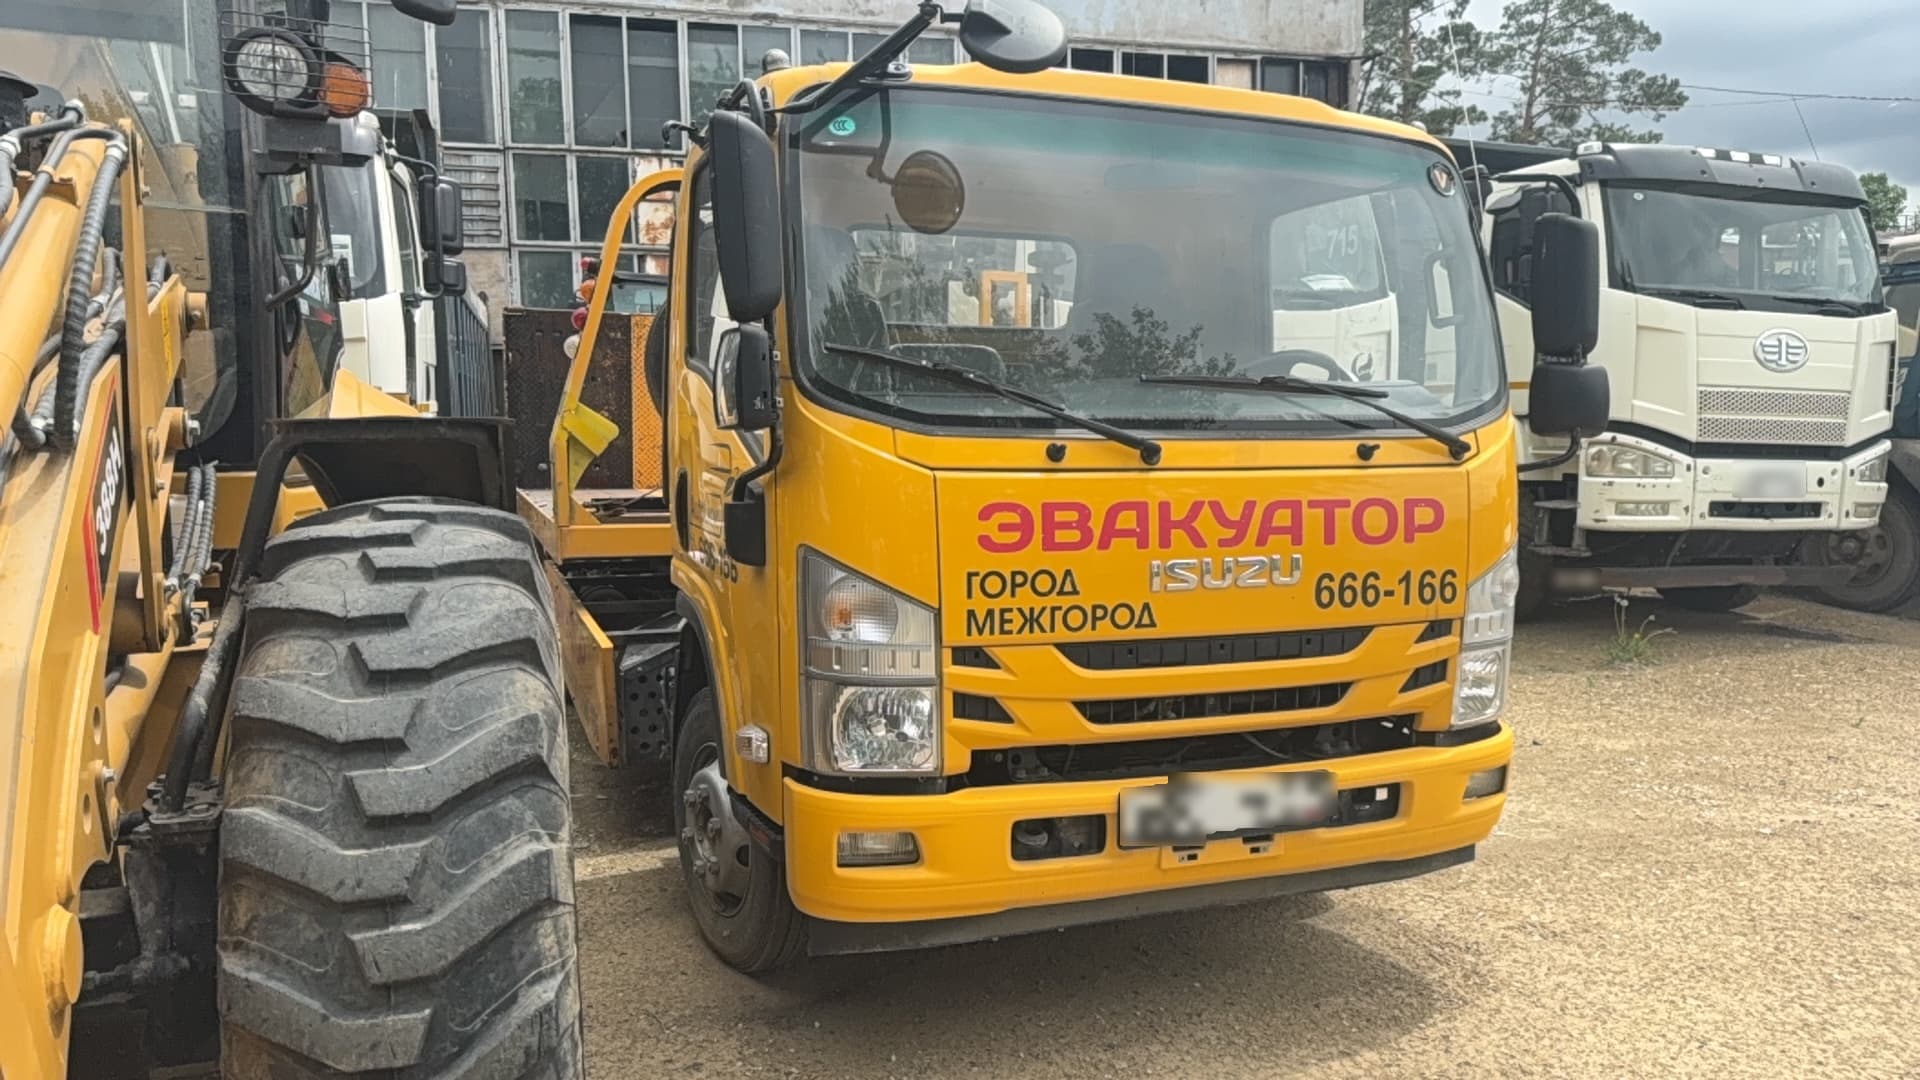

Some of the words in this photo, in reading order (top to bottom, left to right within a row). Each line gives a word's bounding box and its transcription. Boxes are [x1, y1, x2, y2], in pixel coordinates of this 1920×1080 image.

[96, 425, 122, 556] 388H
[977, 498, 1445, 553] ЭВАКУАТОР
[966, 569, 1080, 600] ГОРОД
[1151, 554, 1303, 593] ISUZU
[1314, 568, 1458, 609] 666-166
[966, 602, 1157, 637] МЕЖГОРОД
